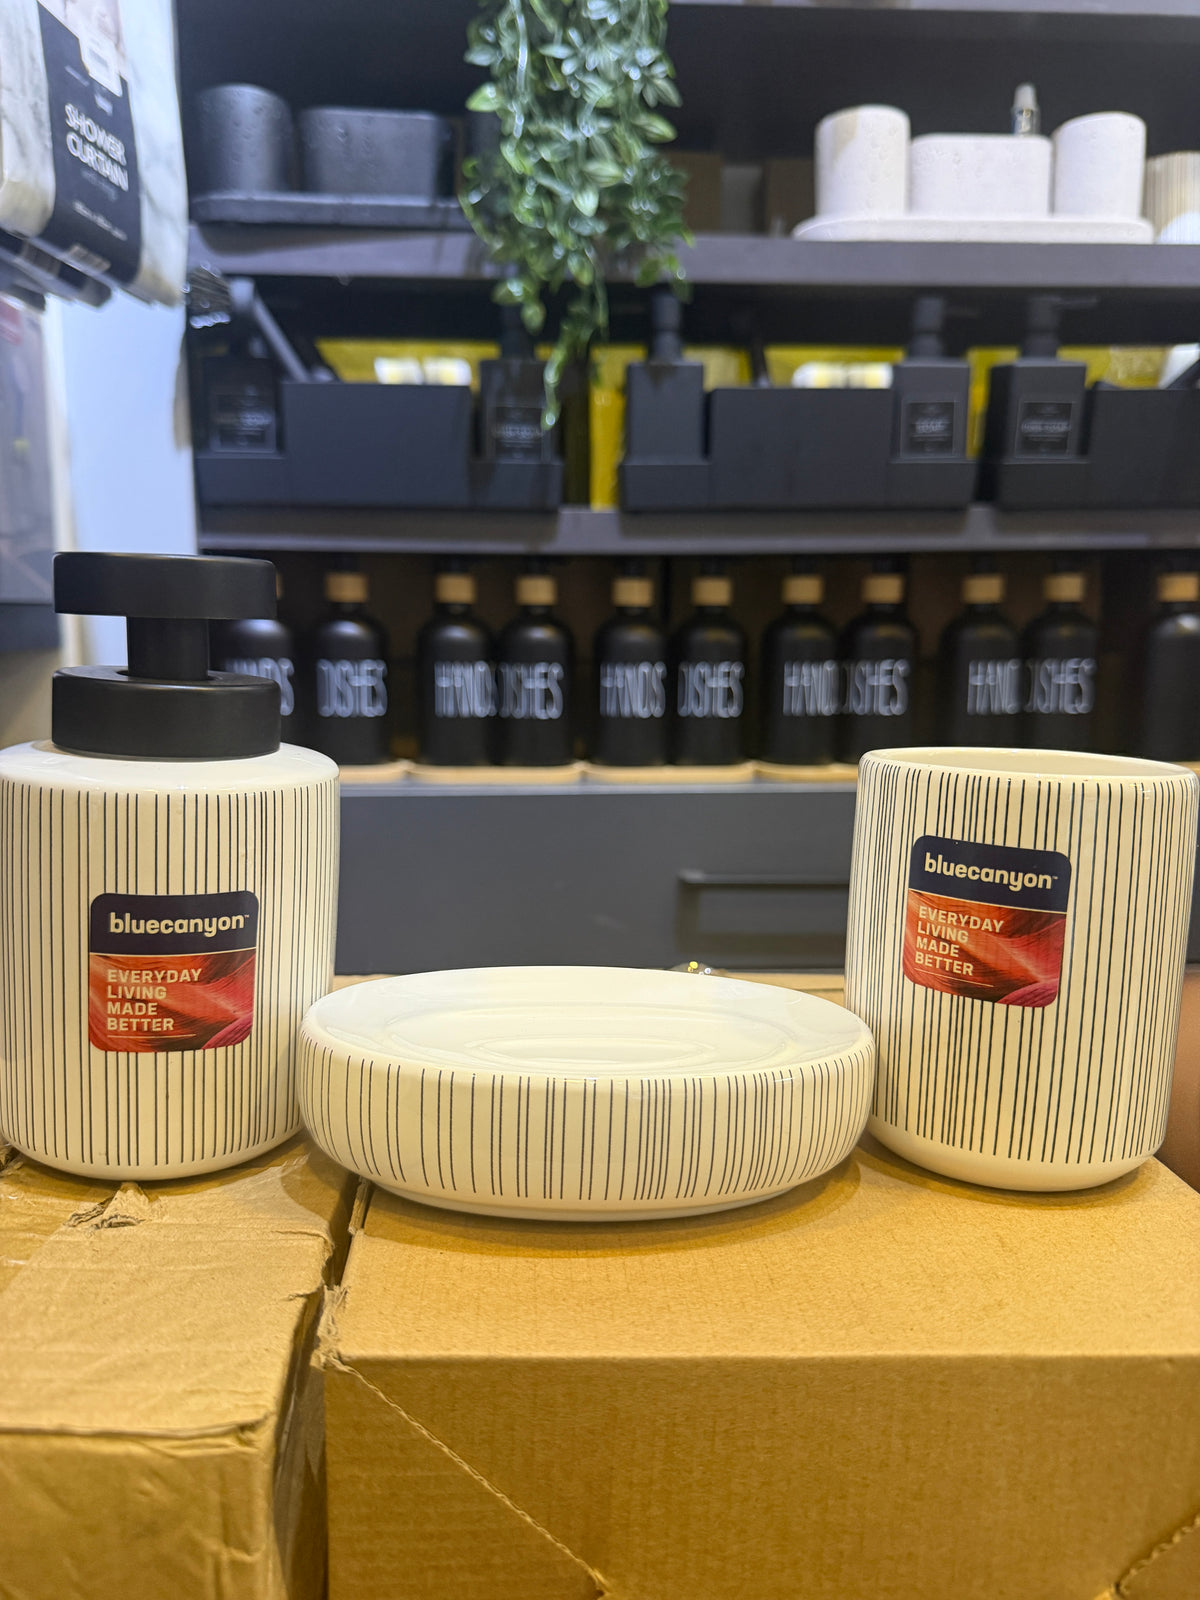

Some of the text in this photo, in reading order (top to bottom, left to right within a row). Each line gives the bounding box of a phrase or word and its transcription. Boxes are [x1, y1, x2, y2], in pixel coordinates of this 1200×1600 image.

[65, 103, 127, 166] SHOWER
[66, 130, 129, 192] CURTAIN
[918, 905, 1004, 933] EVERYDAY
[917, 920, 969, 943] LIVING
[915, 935, 960, 958] MADE
[914, 951, 974, 976] BETTER
[107, 968, 202, 983] EVERYDAY
[107, 985, 167, 1000] LIVING
[107, 1002, 158, 1016] MADE
[107, 1018, 175, 1031] BETTER
